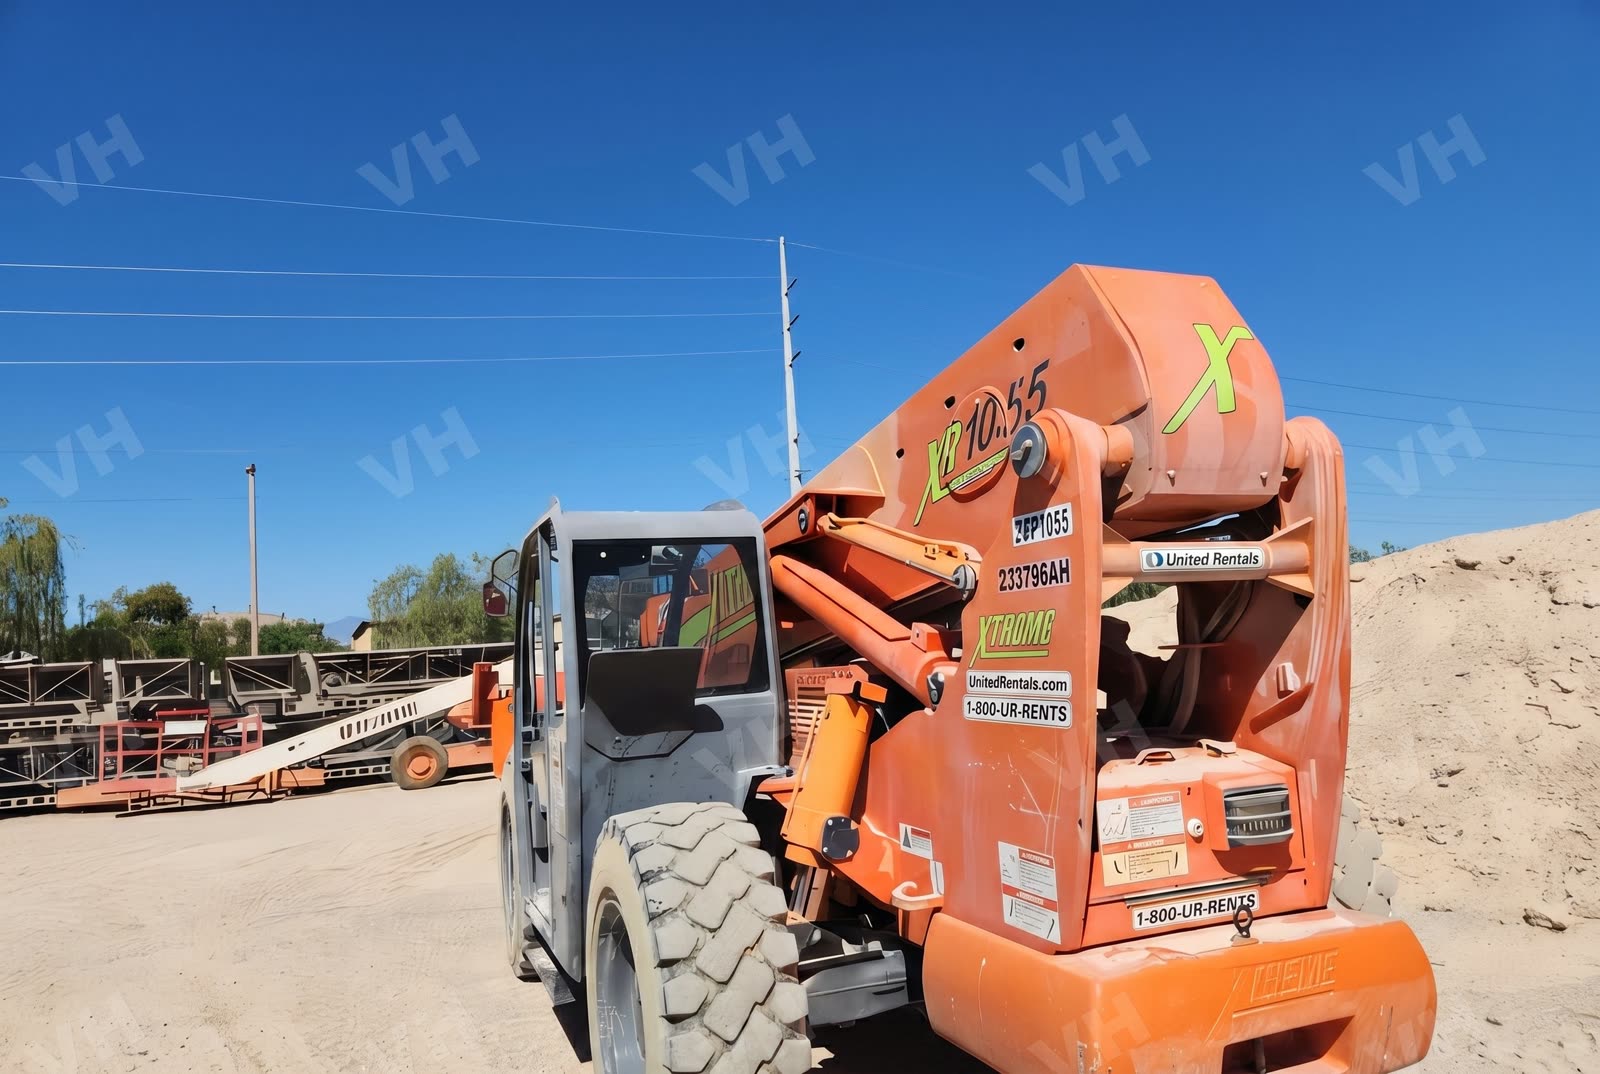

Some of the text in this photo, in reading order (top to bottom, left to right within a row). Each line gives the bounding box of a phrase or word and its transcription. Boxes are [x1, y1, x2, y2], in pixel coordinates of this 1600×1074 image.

[1162, 323, 1255, 434] X
[1166, 552, 1259, 566] United Rentals
[998, 558, 1070, 592] 233796AH
[969, 675, 1067, 692] UnitedRentals.com
[966, 701, 1067, 722] 1-800-UR-RENTS
[1137, 893, 1256, 926] 1-800-UR-RENTS
